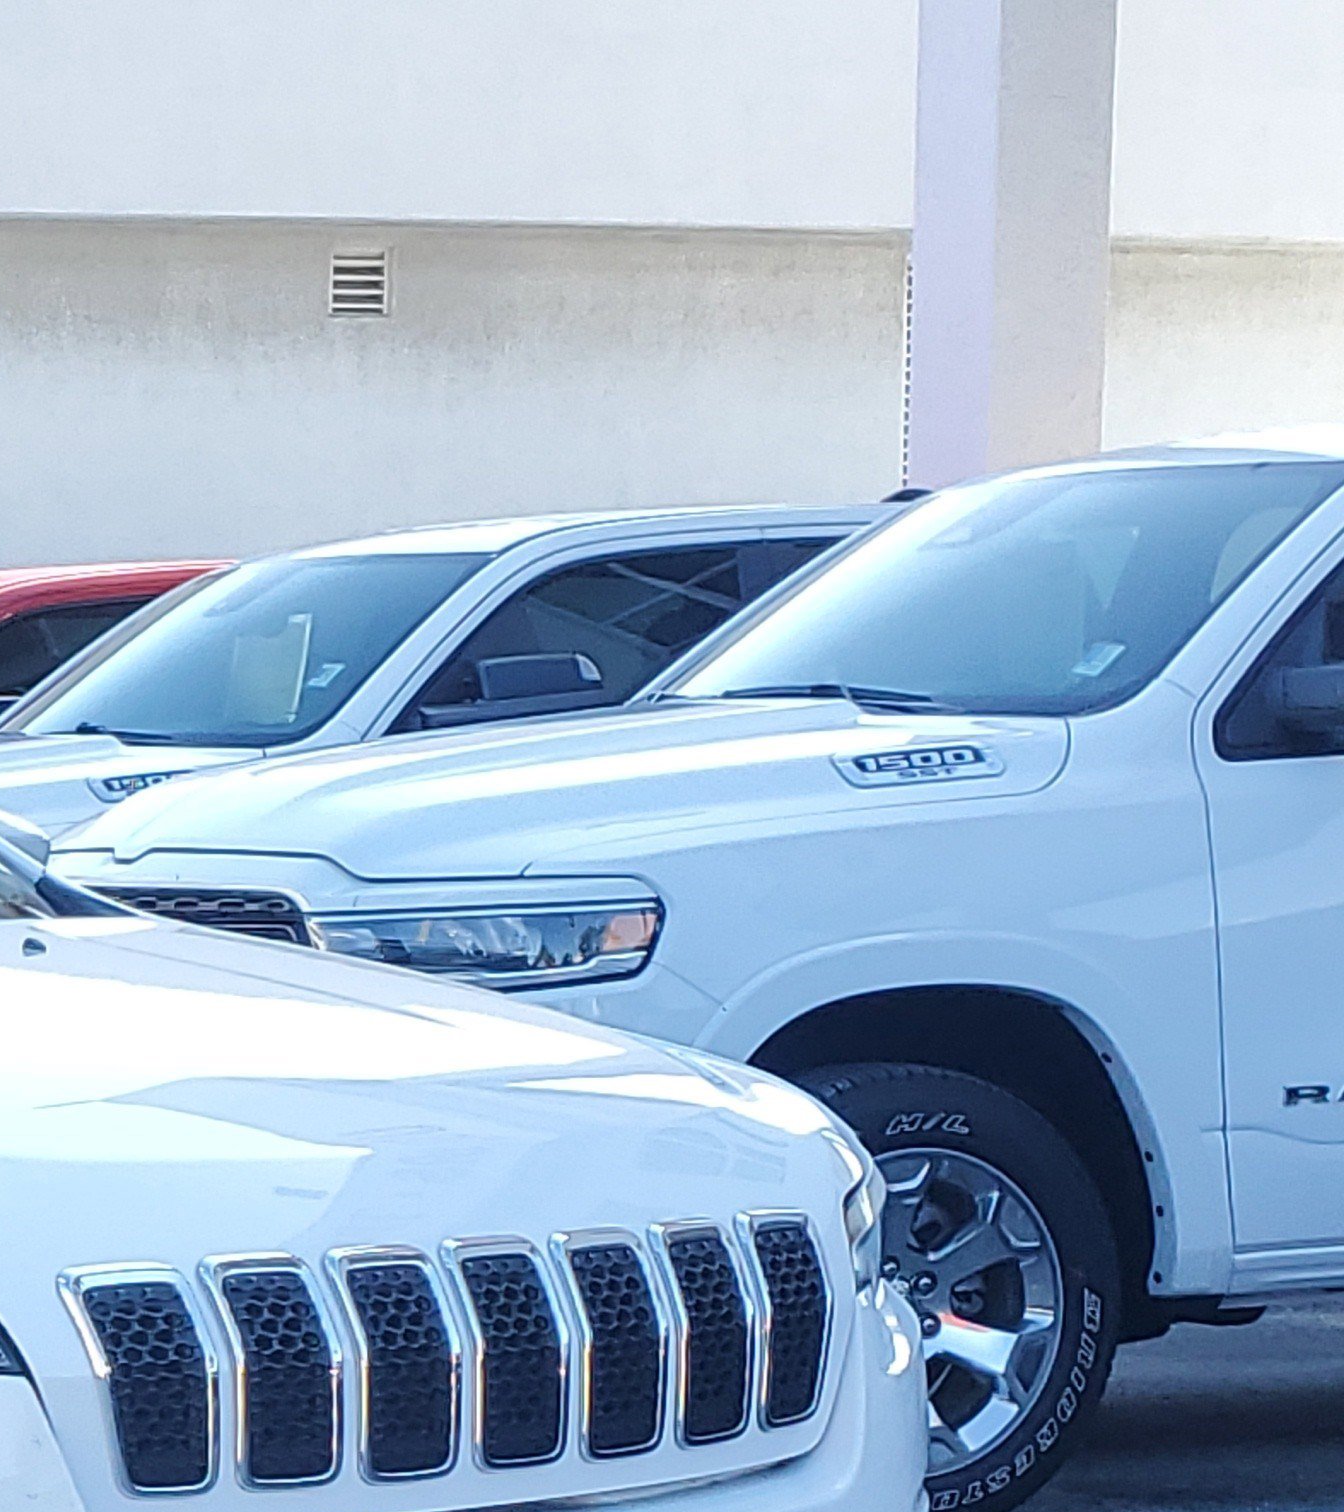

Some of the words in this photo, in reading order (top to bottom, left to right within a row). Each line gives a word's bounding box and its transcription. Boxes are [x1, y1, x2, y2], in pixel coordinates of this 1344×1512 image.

[857, 748, 977, 773] 1500
[1283, 1085, 1344, 1107] R
[885, 1112, 970, 1136] H/L
[931, 1286, 1101, 1511] BRIDGESTO
